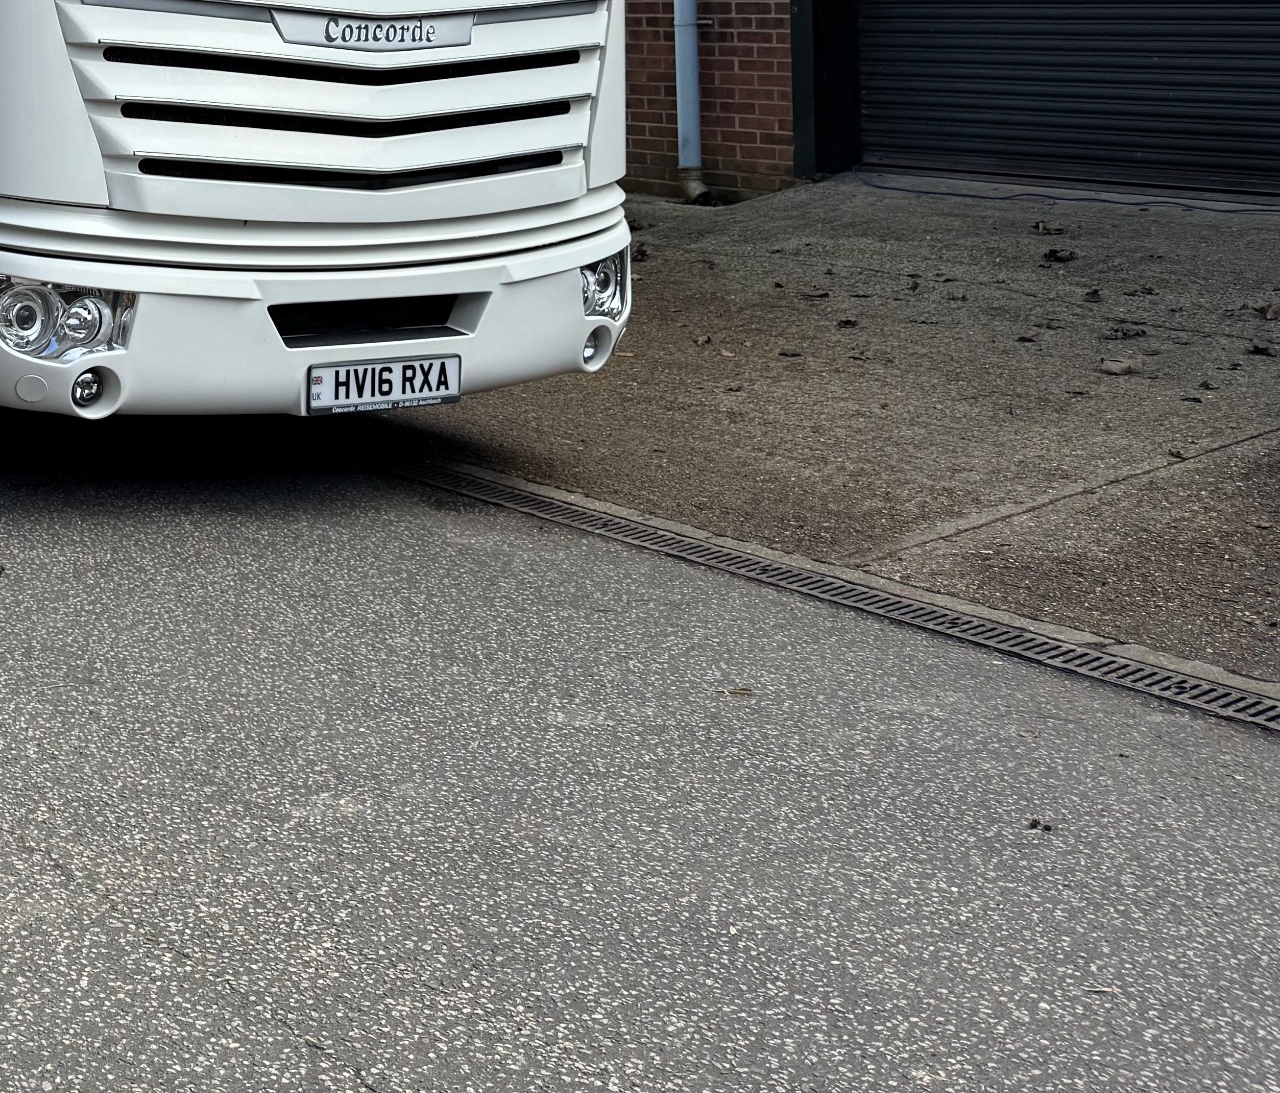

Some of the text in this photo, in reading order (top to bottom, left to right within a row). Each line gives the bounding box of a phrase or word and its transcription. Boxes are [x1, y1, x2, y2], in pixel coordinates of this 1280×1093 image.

[324, 16, 436, 43] Concorde
[334, 361, 450, 400] HV16 RXA
[311, 392, 322, 401] UK
